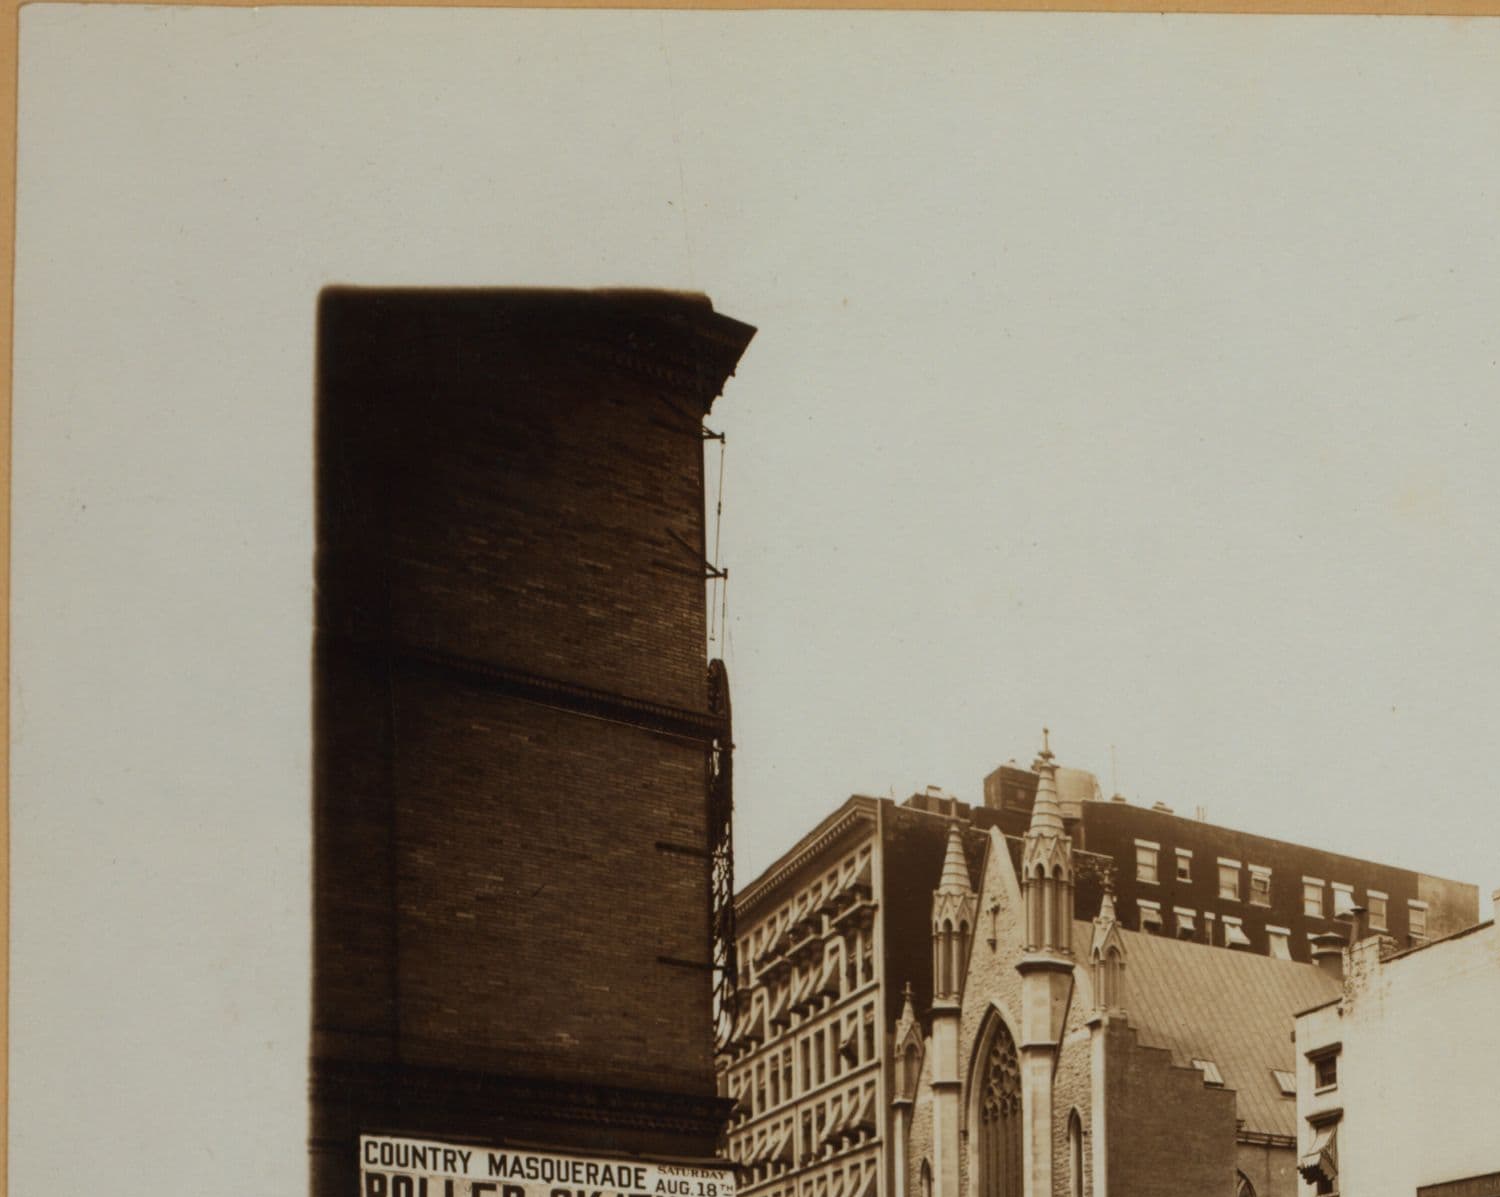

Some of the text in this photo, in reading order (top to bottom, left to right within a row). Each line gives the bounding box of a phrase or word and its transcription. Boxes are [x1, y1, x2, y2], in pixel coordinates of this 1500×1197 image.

[364, 1140, 648, 1190] COUNTRY MASQUERADE
[656, 1165, 727, 1180] SATURDAY
[655, 1179, 694, 1196] AUG.
